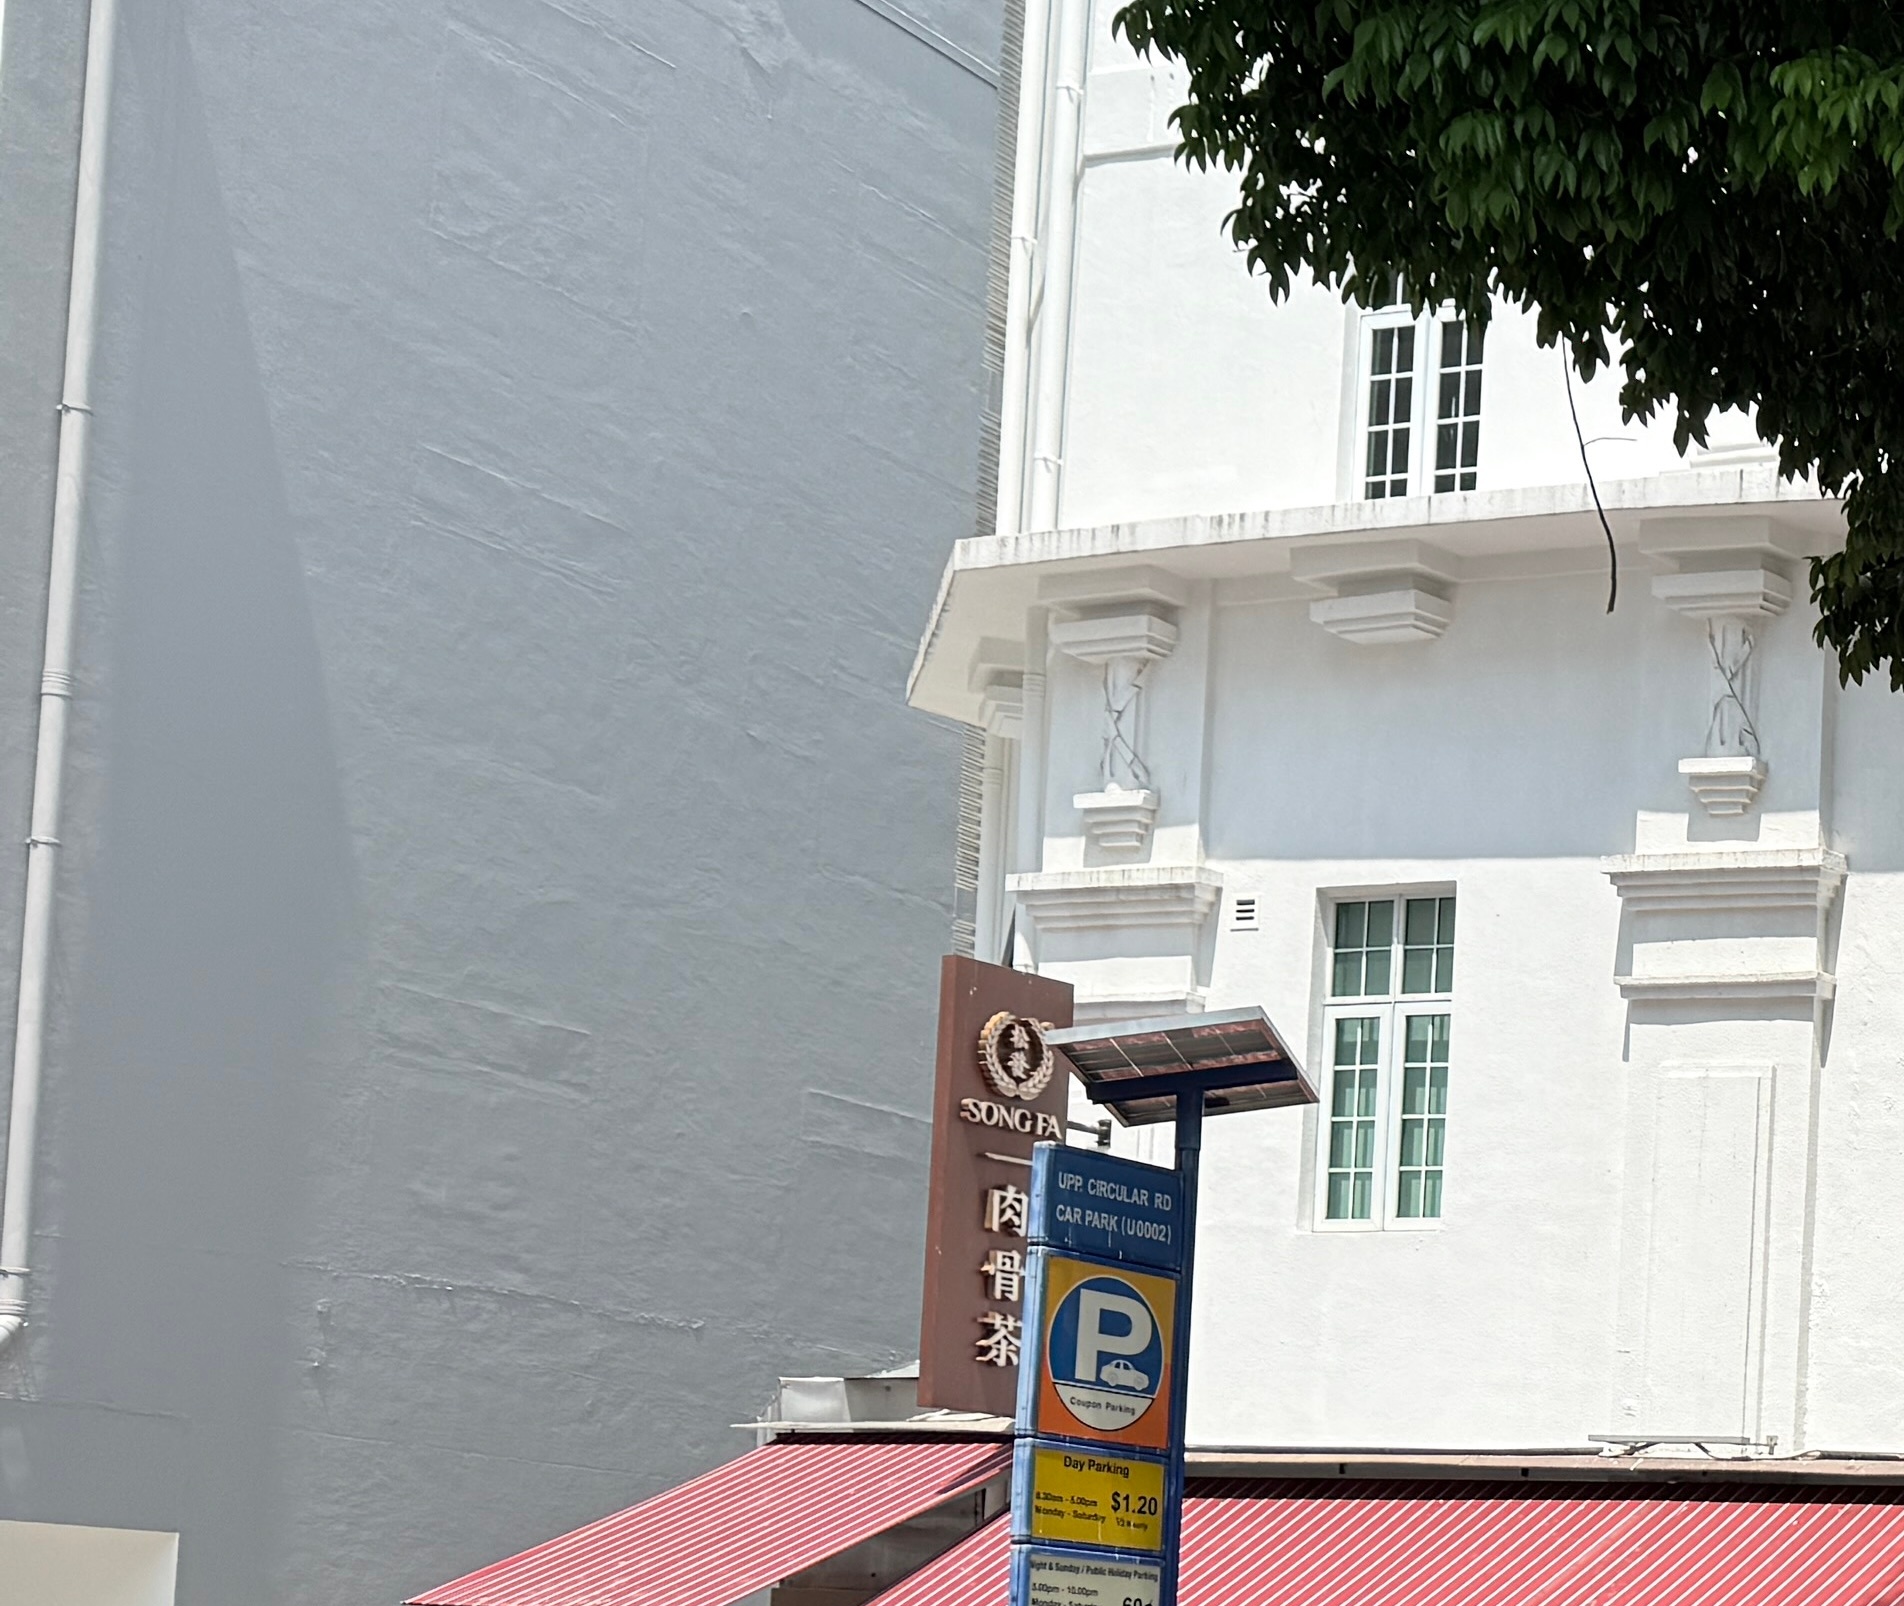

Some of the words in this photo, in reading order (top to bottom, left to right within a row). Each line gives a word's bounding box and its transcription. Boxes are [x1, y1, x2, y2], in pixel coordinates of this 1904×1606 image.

[961, 1098, 1033, 1133] SONG
[1035, 1112, 1063, 1140] FA
[1058, 1171, 1083, 1193] UPP.
[1087, 1178, 1149, 1207] CIRCULAR
[1154, 1193, 1172, 1211] RD
[1056, 1204, 1082, 1225] CAR
[1085, 1210, 1118, 1232] PARK
[1121, 1216, 1172, 1245] (U0002)
[976, 1184, 1030, 1368] 肉骨茶
[1075, 1288, 1152, 1382] P
[1070, 1396, 1102, 1410] Coupon
[1105, 1400, 1136, 1416] Parking
[1063, 1455, 1086, 1472] Day
[1088, 1459, 1129, 1478] Parking
[1073, 1509, 1106, 1524] Saturday
[1111, 1490, 1158, 1516] $1.20
[1055, 1562, 1080, 1575] Sunday
[1086, 1565, 1106, 1577] Public
[1108, 1567, 1132, 1580] Holiday
[1133, 1569, 1158, 1583] Parking
